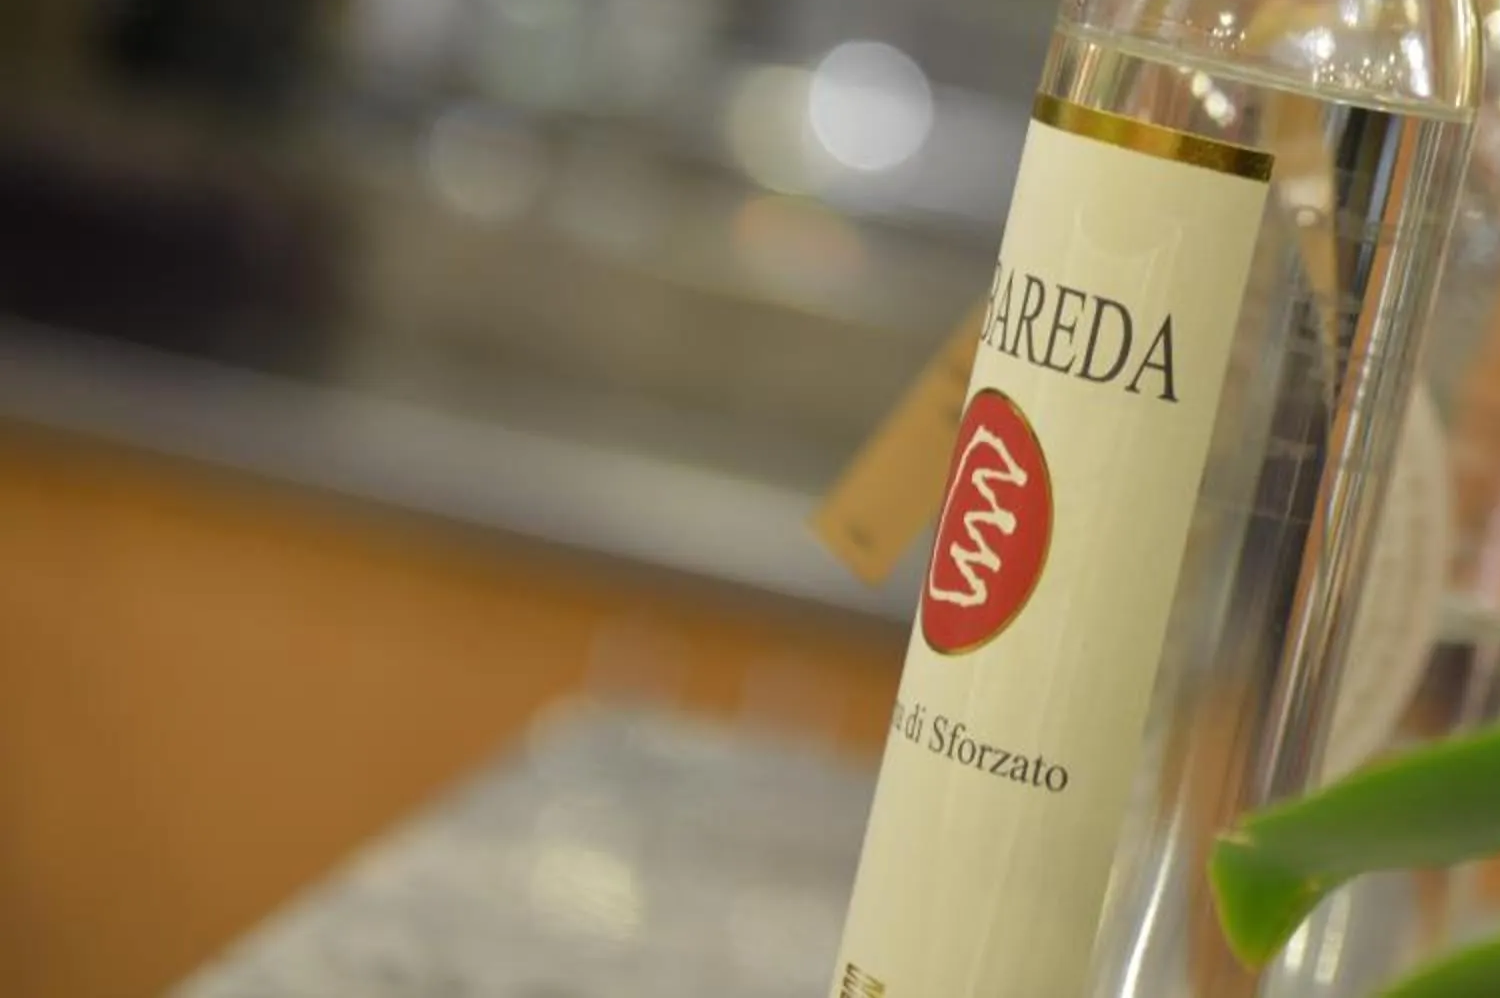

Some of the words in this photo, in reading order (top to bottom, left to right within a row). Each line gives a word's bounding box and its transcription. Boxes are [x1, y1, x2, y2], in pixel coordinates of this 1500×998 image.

[980, 259, 1179, 403] AREDA
[904, 702, 926, 744] di
[928, 713, 1069, 794] Sforzato
